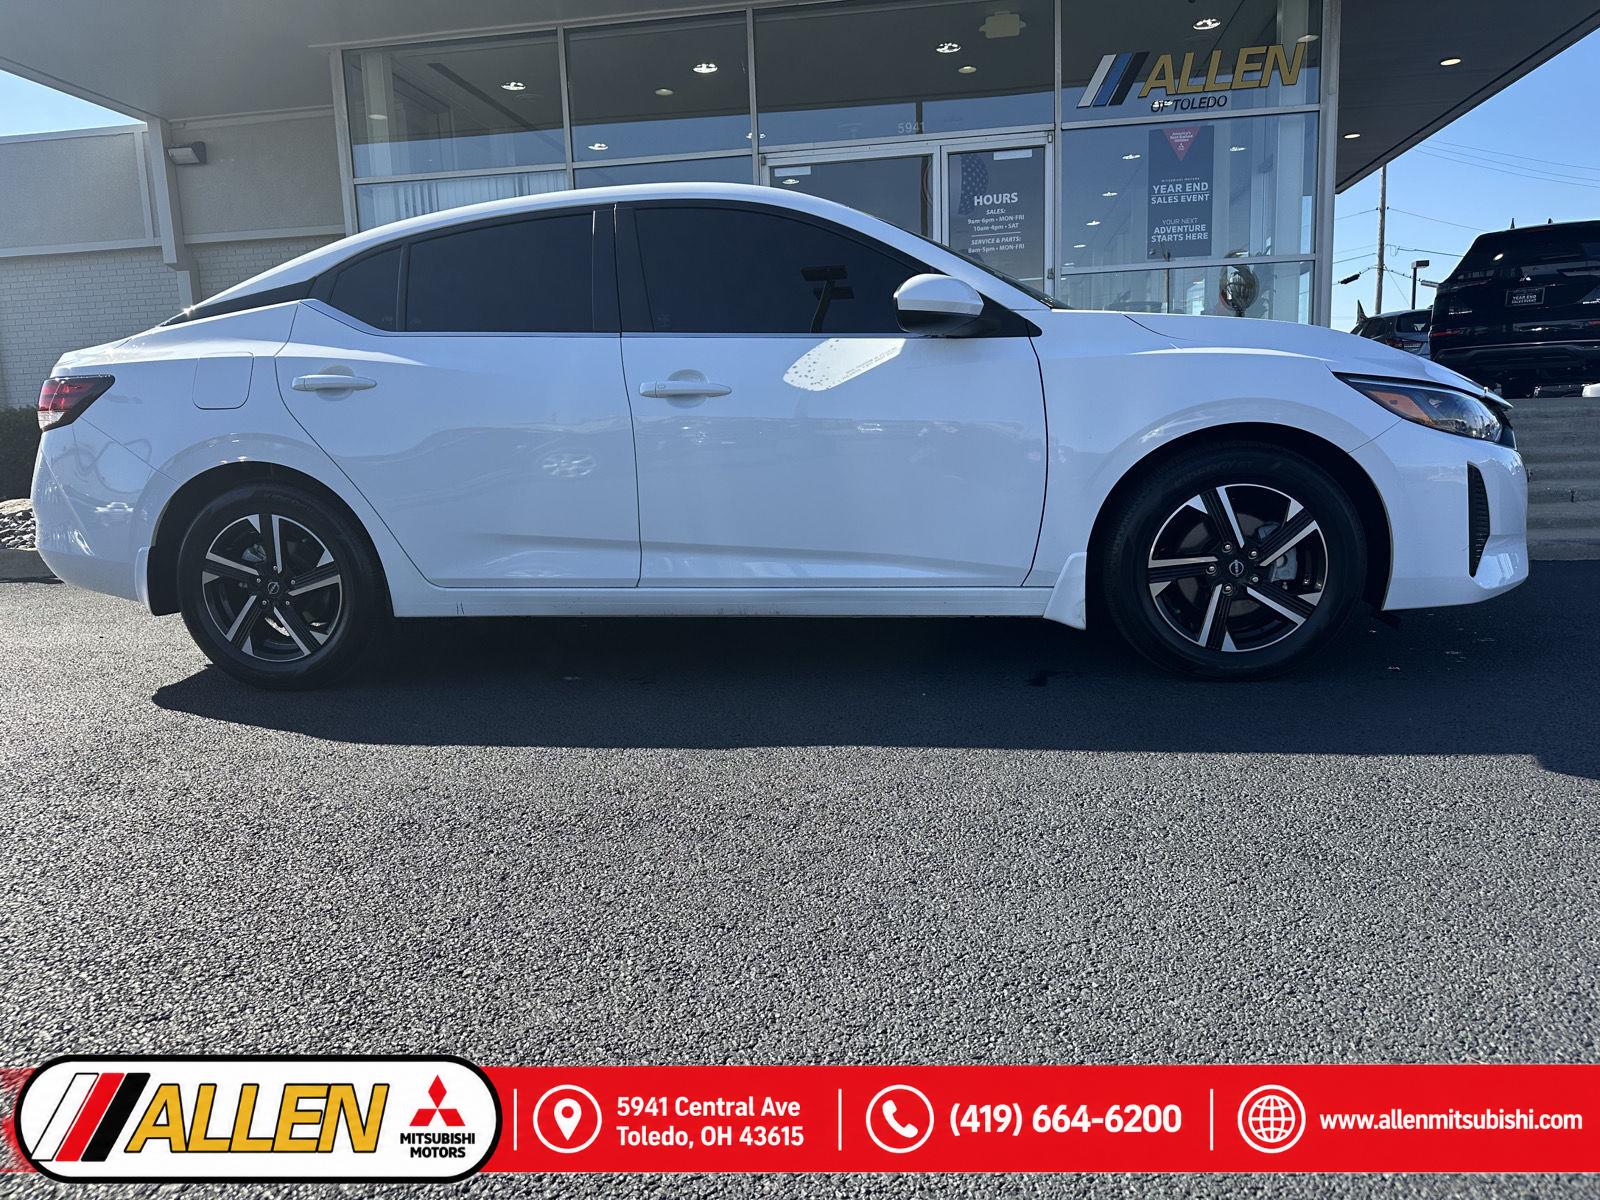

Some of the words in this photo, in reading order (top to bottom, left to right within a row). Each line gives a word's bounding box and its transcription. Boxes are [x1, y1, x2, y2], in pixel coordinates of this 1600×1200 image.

[1138, 42, 1306, 98] ALLEN
[1173, 95, 1228, 111] TOLEDO
[1152, 183, 1183, 194] YEAR
[1185, 182, 1209, 191] END
[973, 192, 1019, 206] HOURS
[1151, 195, 1179, 205] SALES
[1180, 193, 1210, 203] EVENT
[998, 214, 1025, 222] MON-FRI
[1161, 218, 1180, 226] YOUR
[1153, 224, 1206, 234] ADVENTURE
[1151, 233, 1184, 243] STARTS
[1185, 232, 1209, 241] HERE
[999, 243, 1025, 251] MON-FRI
